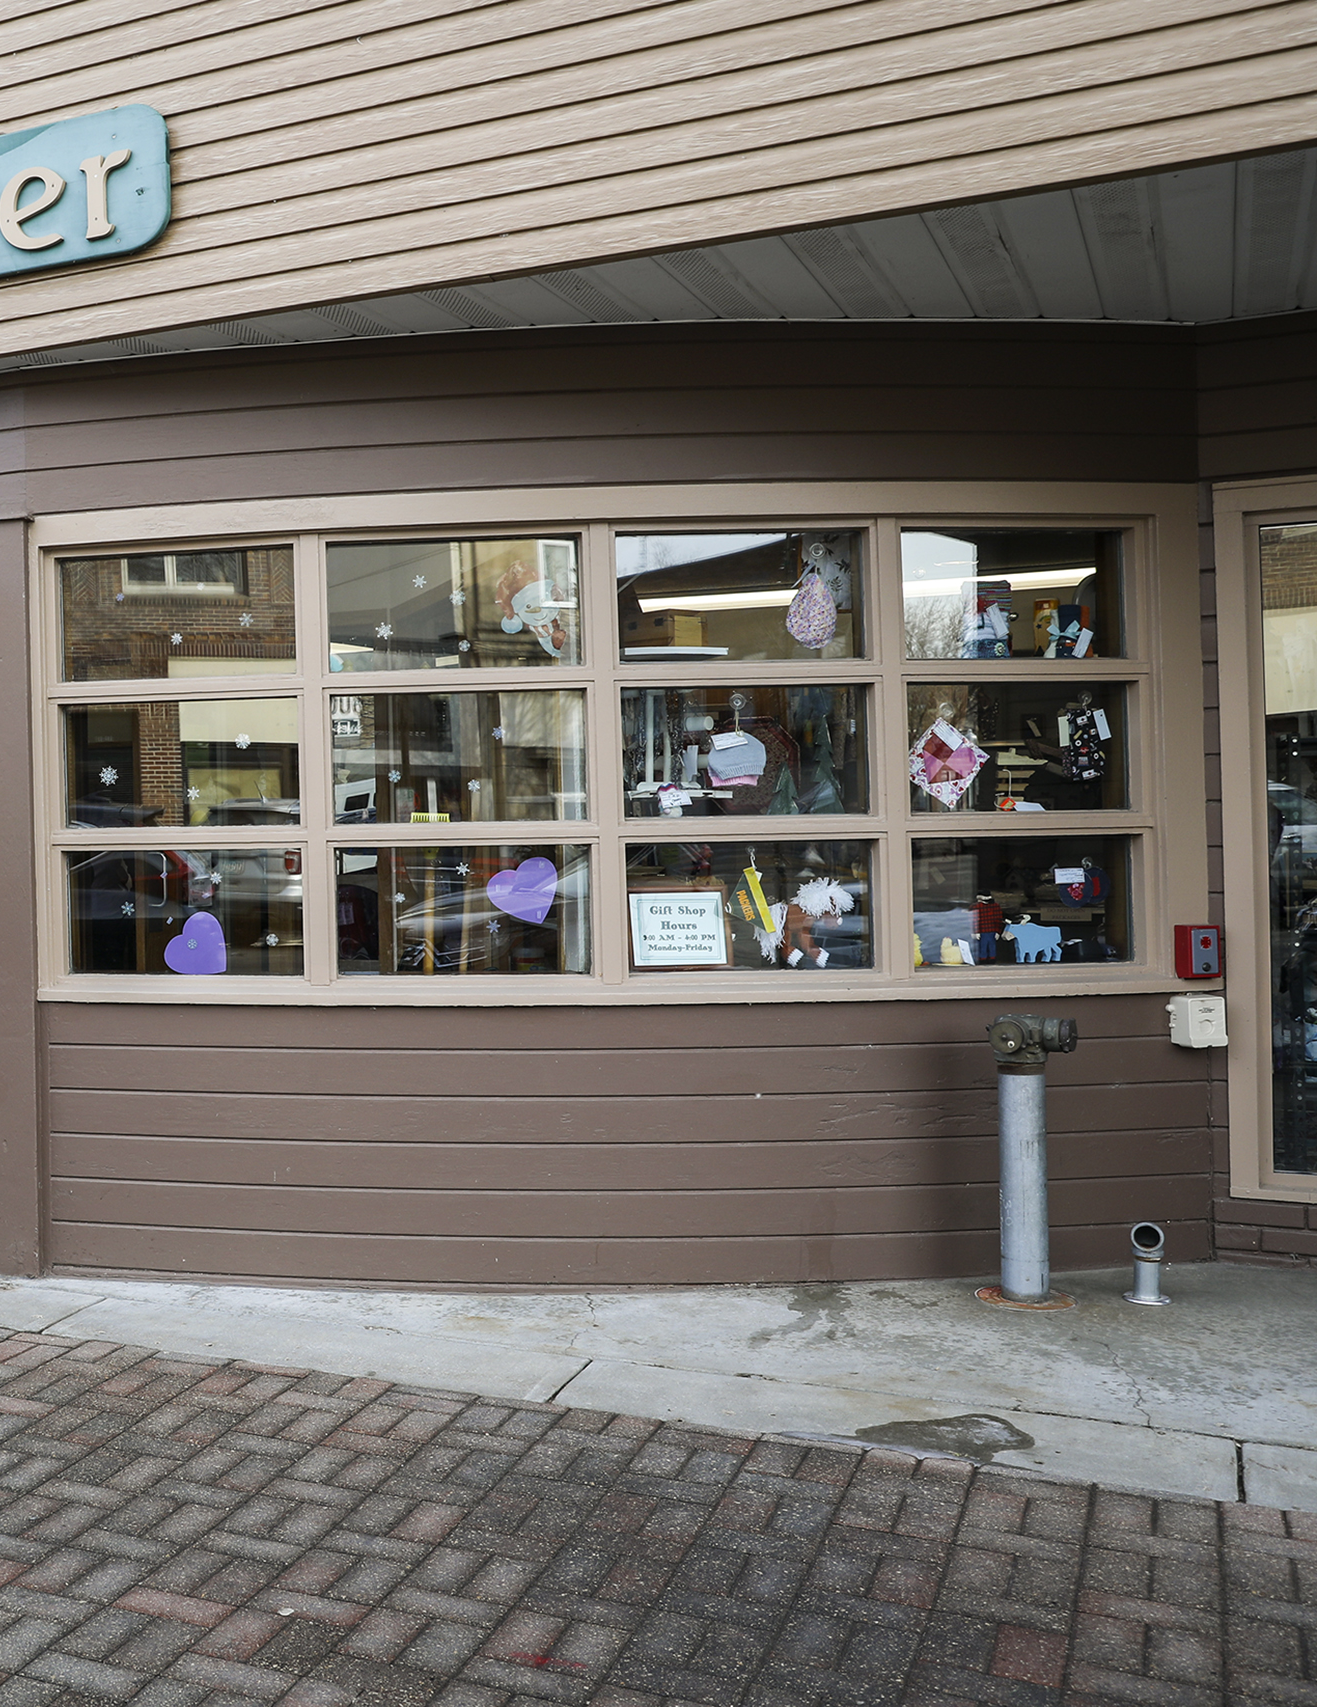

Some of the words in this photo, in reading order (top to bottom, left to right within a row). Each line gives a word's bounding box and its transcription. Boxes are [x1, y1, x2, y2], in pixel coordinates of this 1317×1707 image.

[649, 905, 673, 916] Gift
[678, 904, 706, 918] Shop
[736, 890, 755, 921] PACKERS
[660, 920, 697, 931] Hours
[684, 934, 698, 942] 4:00
[701, 933, 716, 941] PM
[648, 943, 713, 953] Monday-Friday
